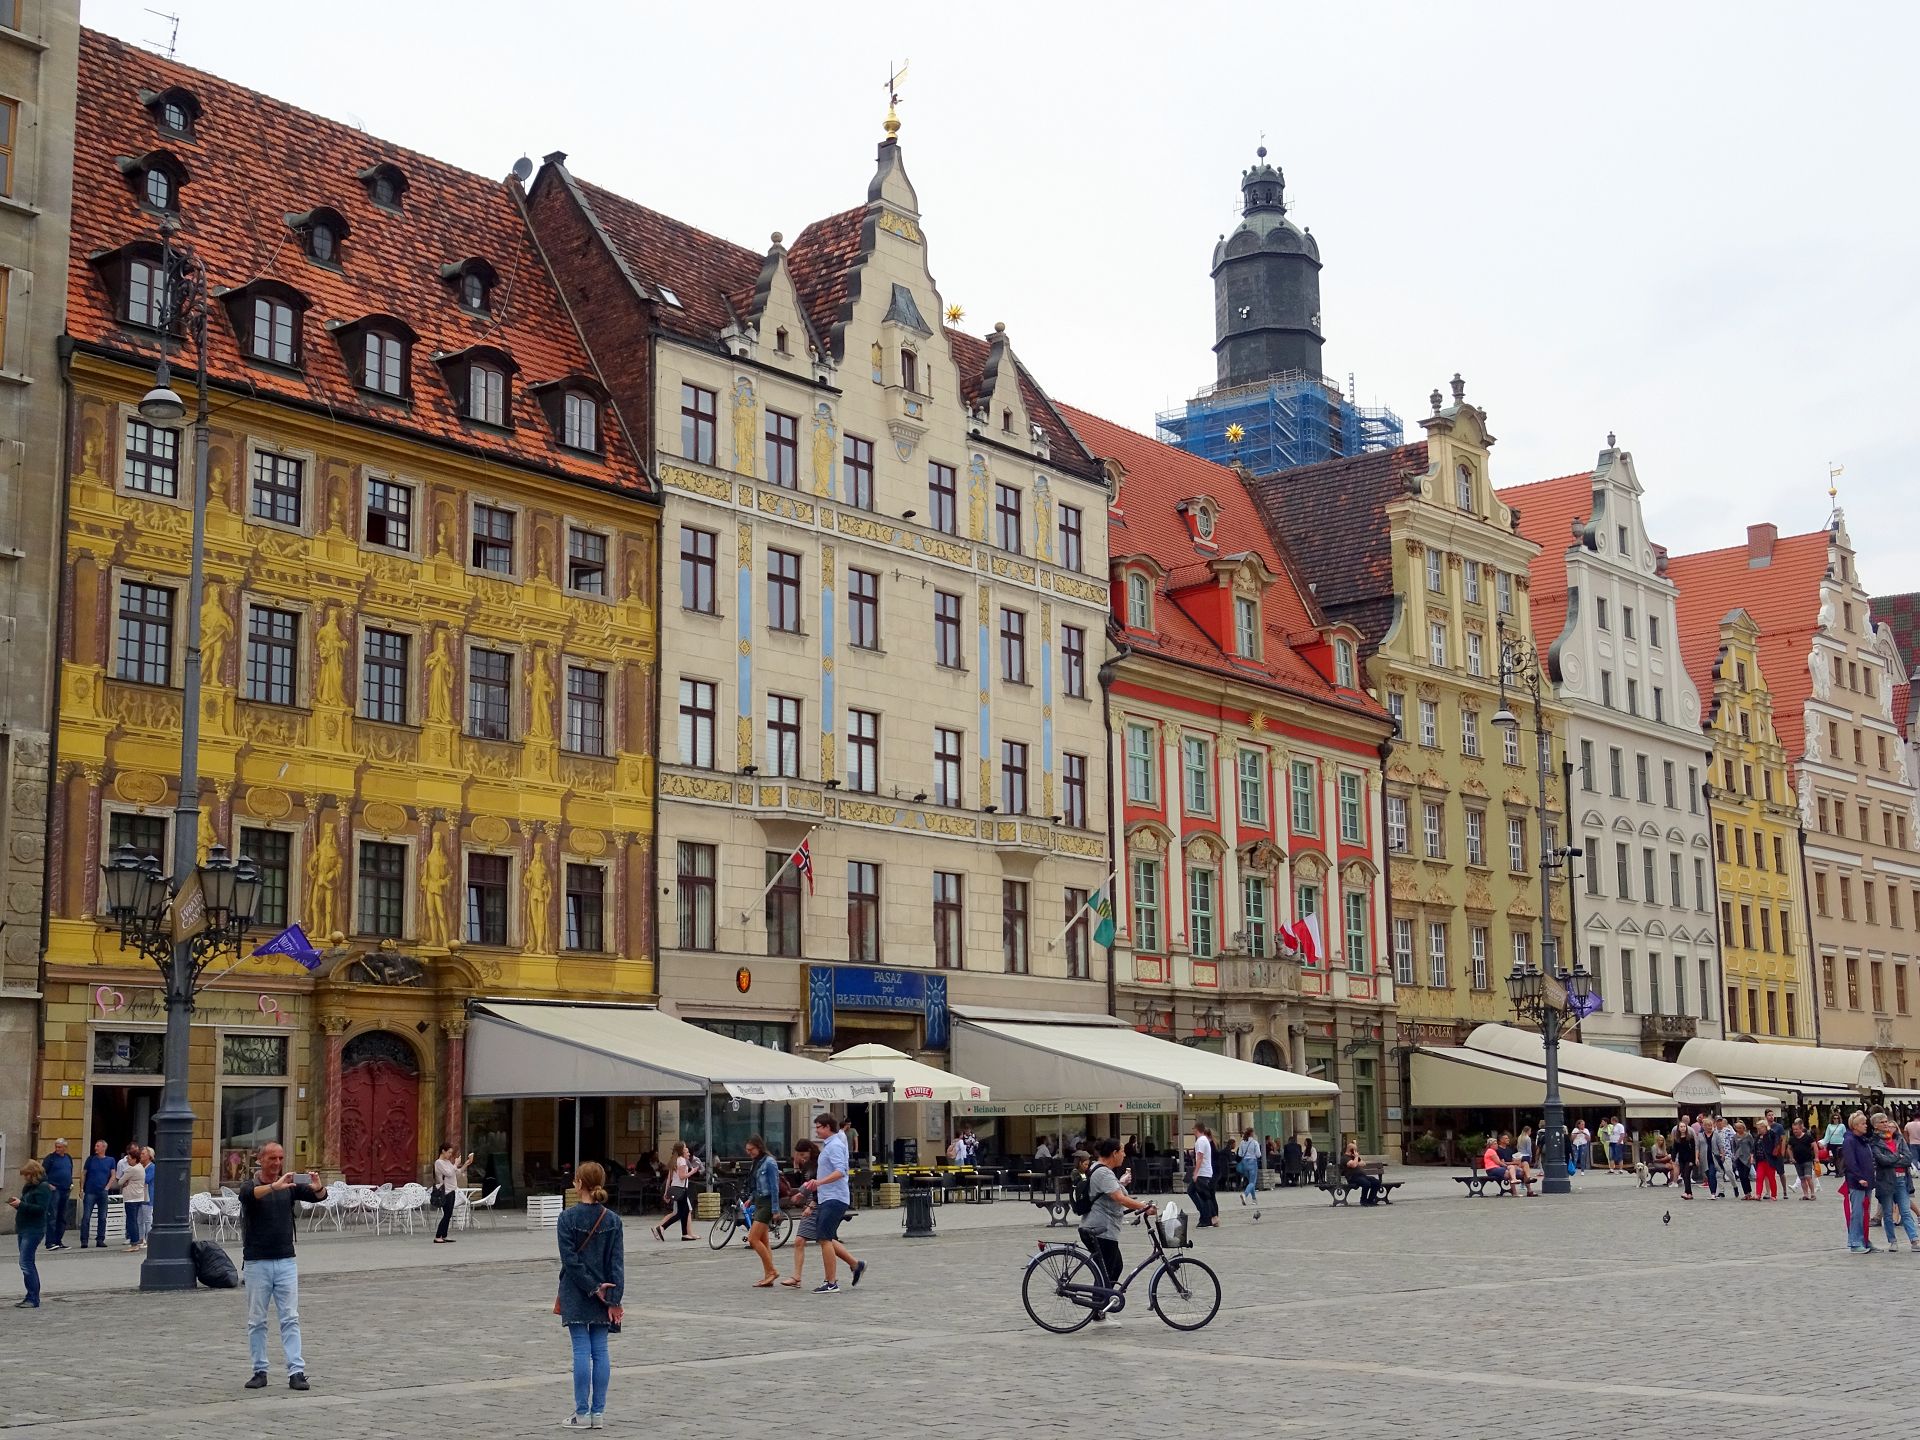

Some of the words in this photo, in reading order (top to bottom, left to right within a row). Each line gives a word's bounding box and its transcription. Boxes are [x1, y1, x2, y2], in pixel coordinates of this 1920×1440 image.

[882, 985, 895, 995] pod
[1428, 1025, 1453, 1038] POLSKI
[973, 1104, 1007, 1113] Heineken
[1023, 1103, 1059, 1113] COFFEE
[1063, 1101, 1100, 1112] PLANET
[1126, 1101, 1161, 1110] Heineken
